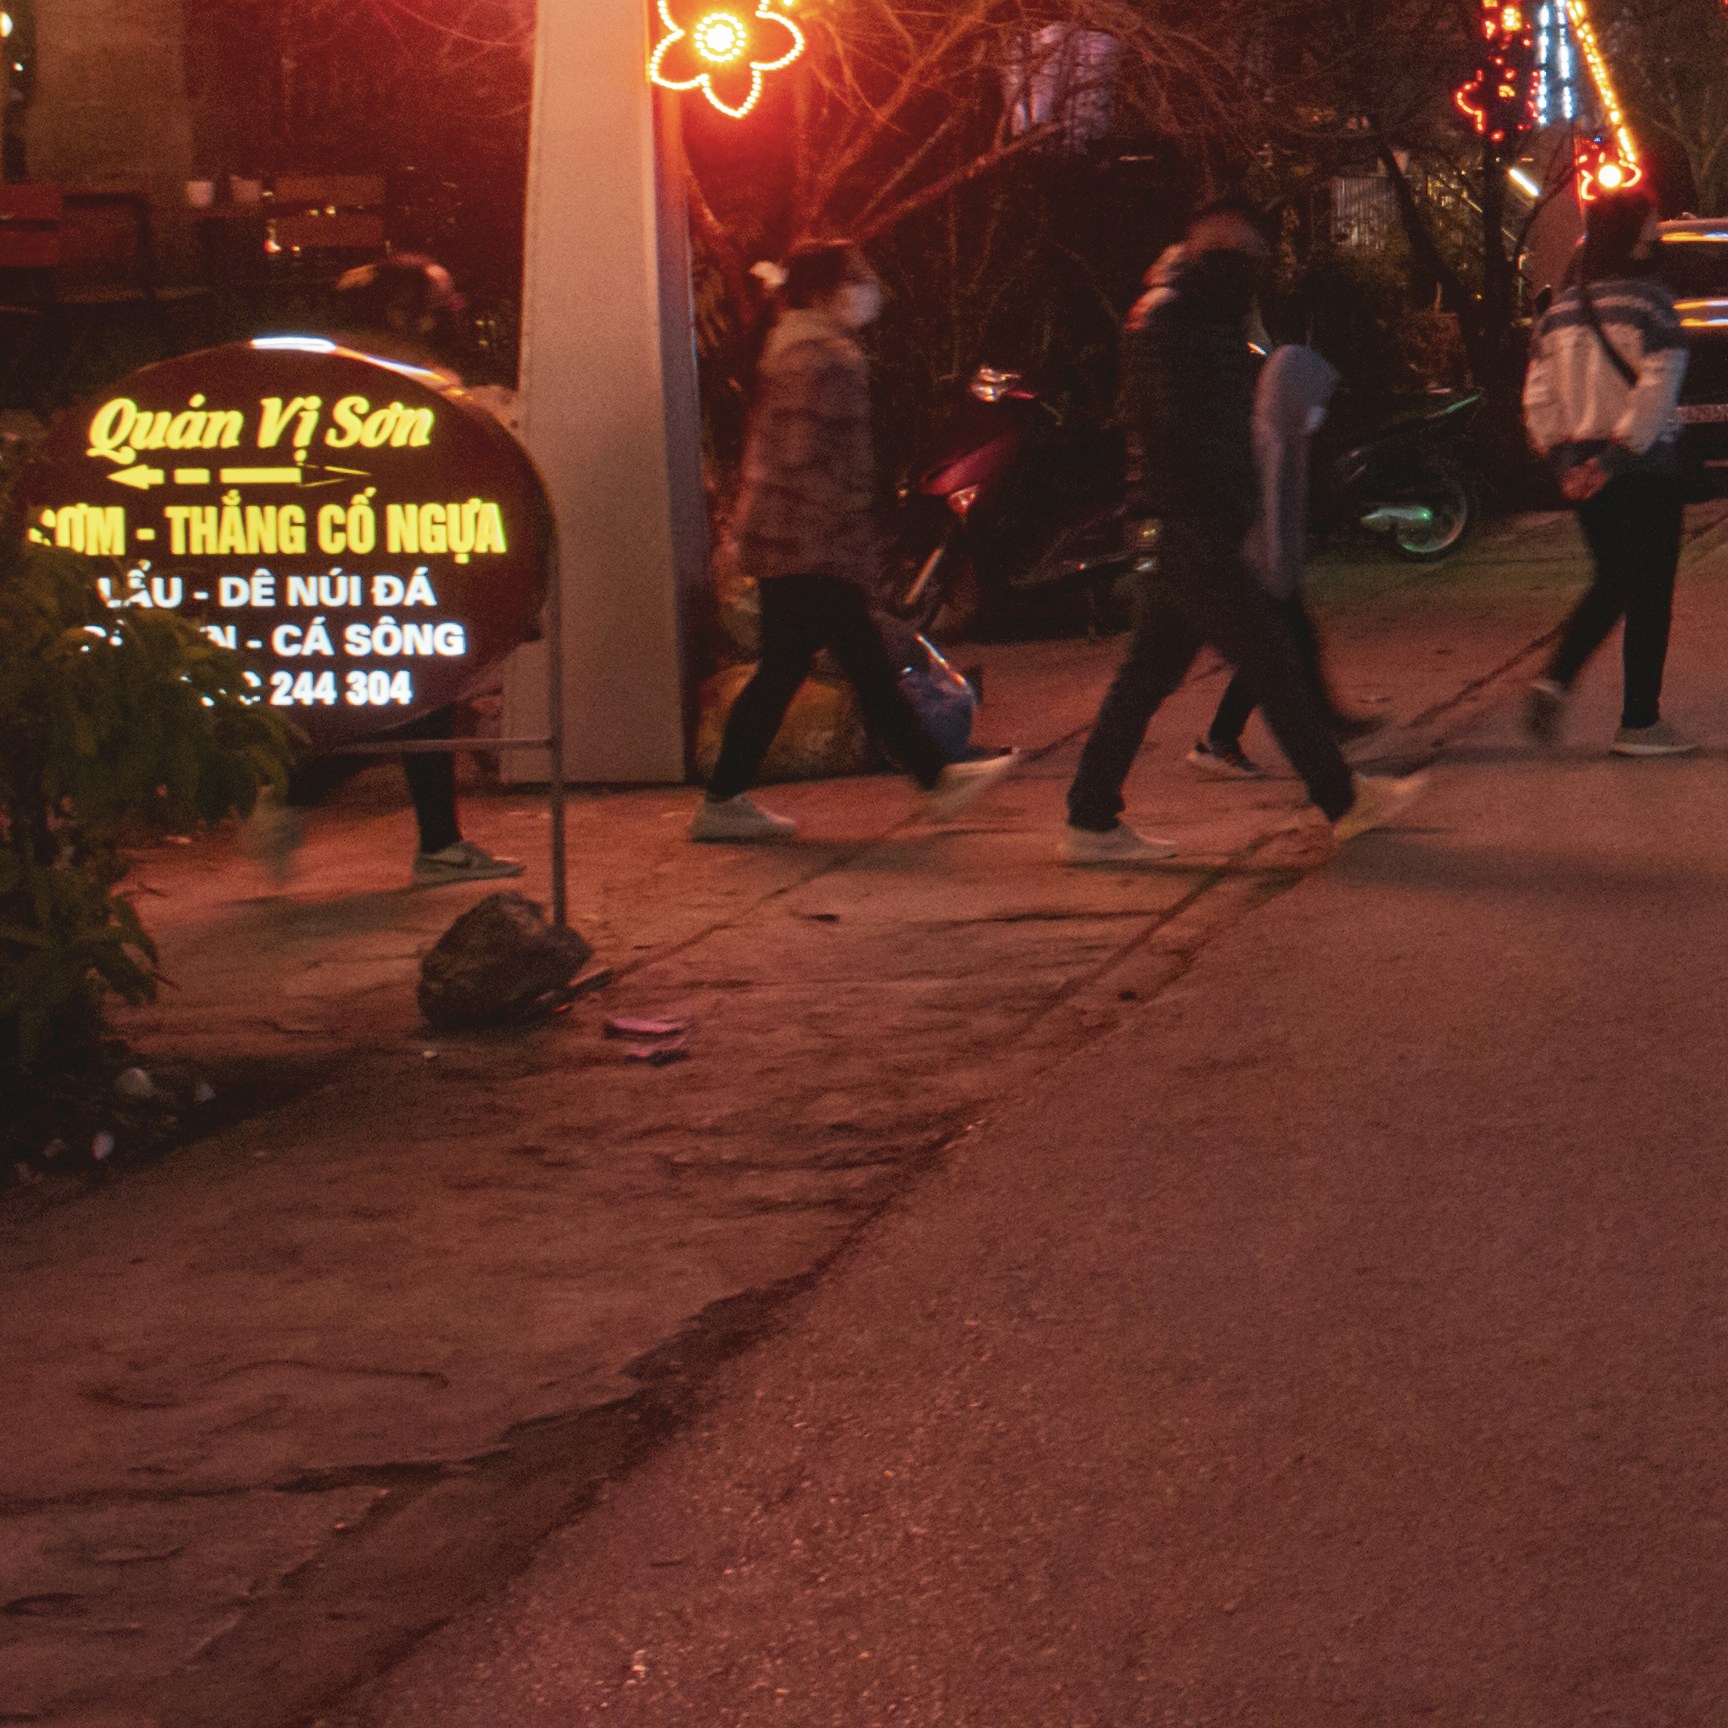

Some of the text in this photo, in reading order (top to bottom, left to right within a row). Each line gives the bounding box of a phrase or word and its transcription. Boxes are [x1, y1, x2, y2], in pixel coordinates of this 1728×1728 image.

[86, 392, 435, 464] Quán Vị Sơn
[317, 485, 379, 555] CỐ
[386, 497, 508, 566] NGỰA
[218, 568, 276, 608] DÊ
[286, 566, 362, 608] NÚI
[371, 565, 438, 608] ĐÁ
[271, 616, 335, 657] CÁ
[344, 615, 466, 657] SÔNG
[270, 671, 337, 707] 244
[345, 670, 412, 707] 304
